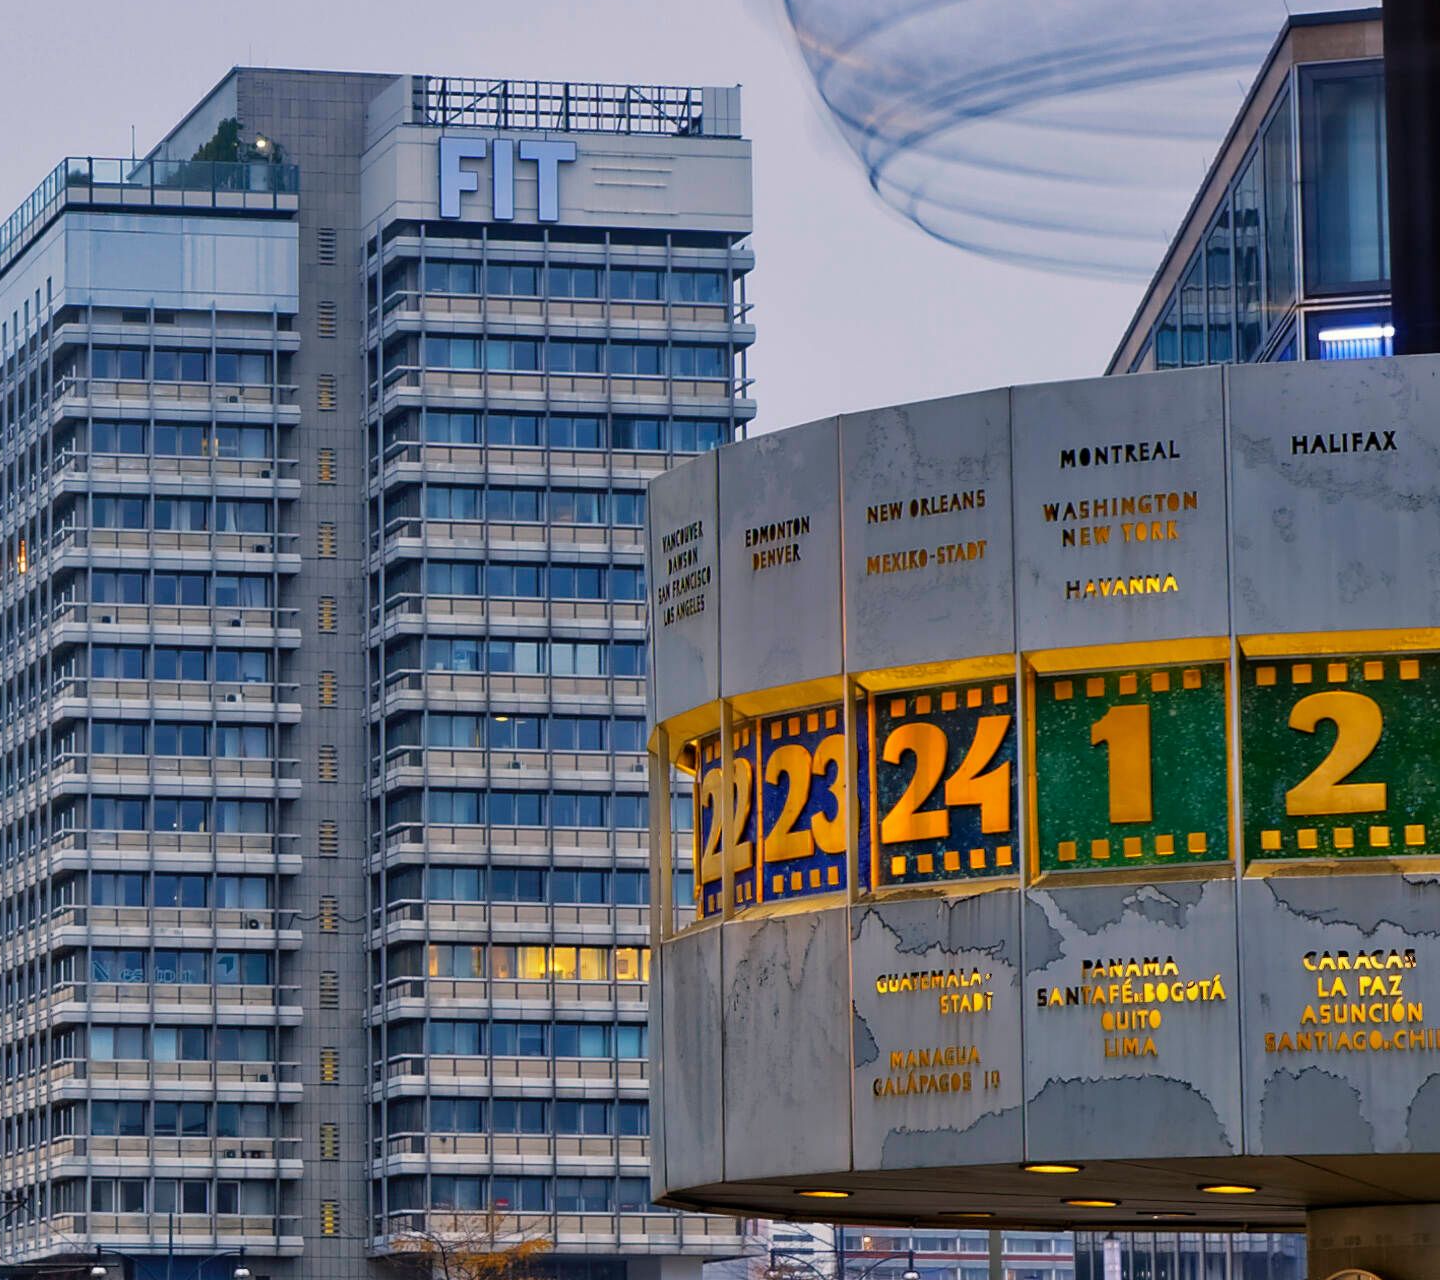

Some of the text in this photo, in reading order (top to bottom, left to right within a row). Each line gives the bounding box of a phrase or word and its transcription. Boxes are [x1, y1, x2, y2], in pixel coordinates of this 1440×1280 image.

[439, 137, 577, 222] FIT
[1060, 440, 1180, 469] MONTREAL
[1291, 431, 1398, 456] HALIFAX
[867, 489, 986, 524] NEW ORLEANS
[1043, 491, 1198, 522] WASHINGTON
[662, 521, 703, 553] VANCOUVER
[745, 516, 810, 548] EDMONTON
[1062, 520, 1179, 547] NEW YORK
[752, 543, 801, 571] DENVER
[866, 539, 987, 576] MEXIKO-STADT
[658, 566, 711, 605] SAN FRANCISCO
[1066, 573, 1179, 600] HAVANNA
[663, 594, 704, 627] LOS ANGELES
[1090, 704, 1153, 823] 1
[1286, 691, 1387, 816] 2
[881, 715, 1012, 844] 24
[765, 733, 848, 863] 23
[1081, 956, 1179, 978] PANAMA
[1303, 949, 1417, 971] CARACAS
[1317, 975, 1403, 997] LA PAZ
[940, 992, 994, 1016] STADT
[1300, 997, 1423, 1025] ASUNCIÓN
[1101, 1009, 1162, 1031] QUITO
[1104, 1037, 1158, 1057] LIMA
[1264, 1030, 1383, 1052] SANTIAGO
[890, 1045, 980, 1070] MANAGUA
[873, 1071, 971, 1097] GALÁPAGOS
